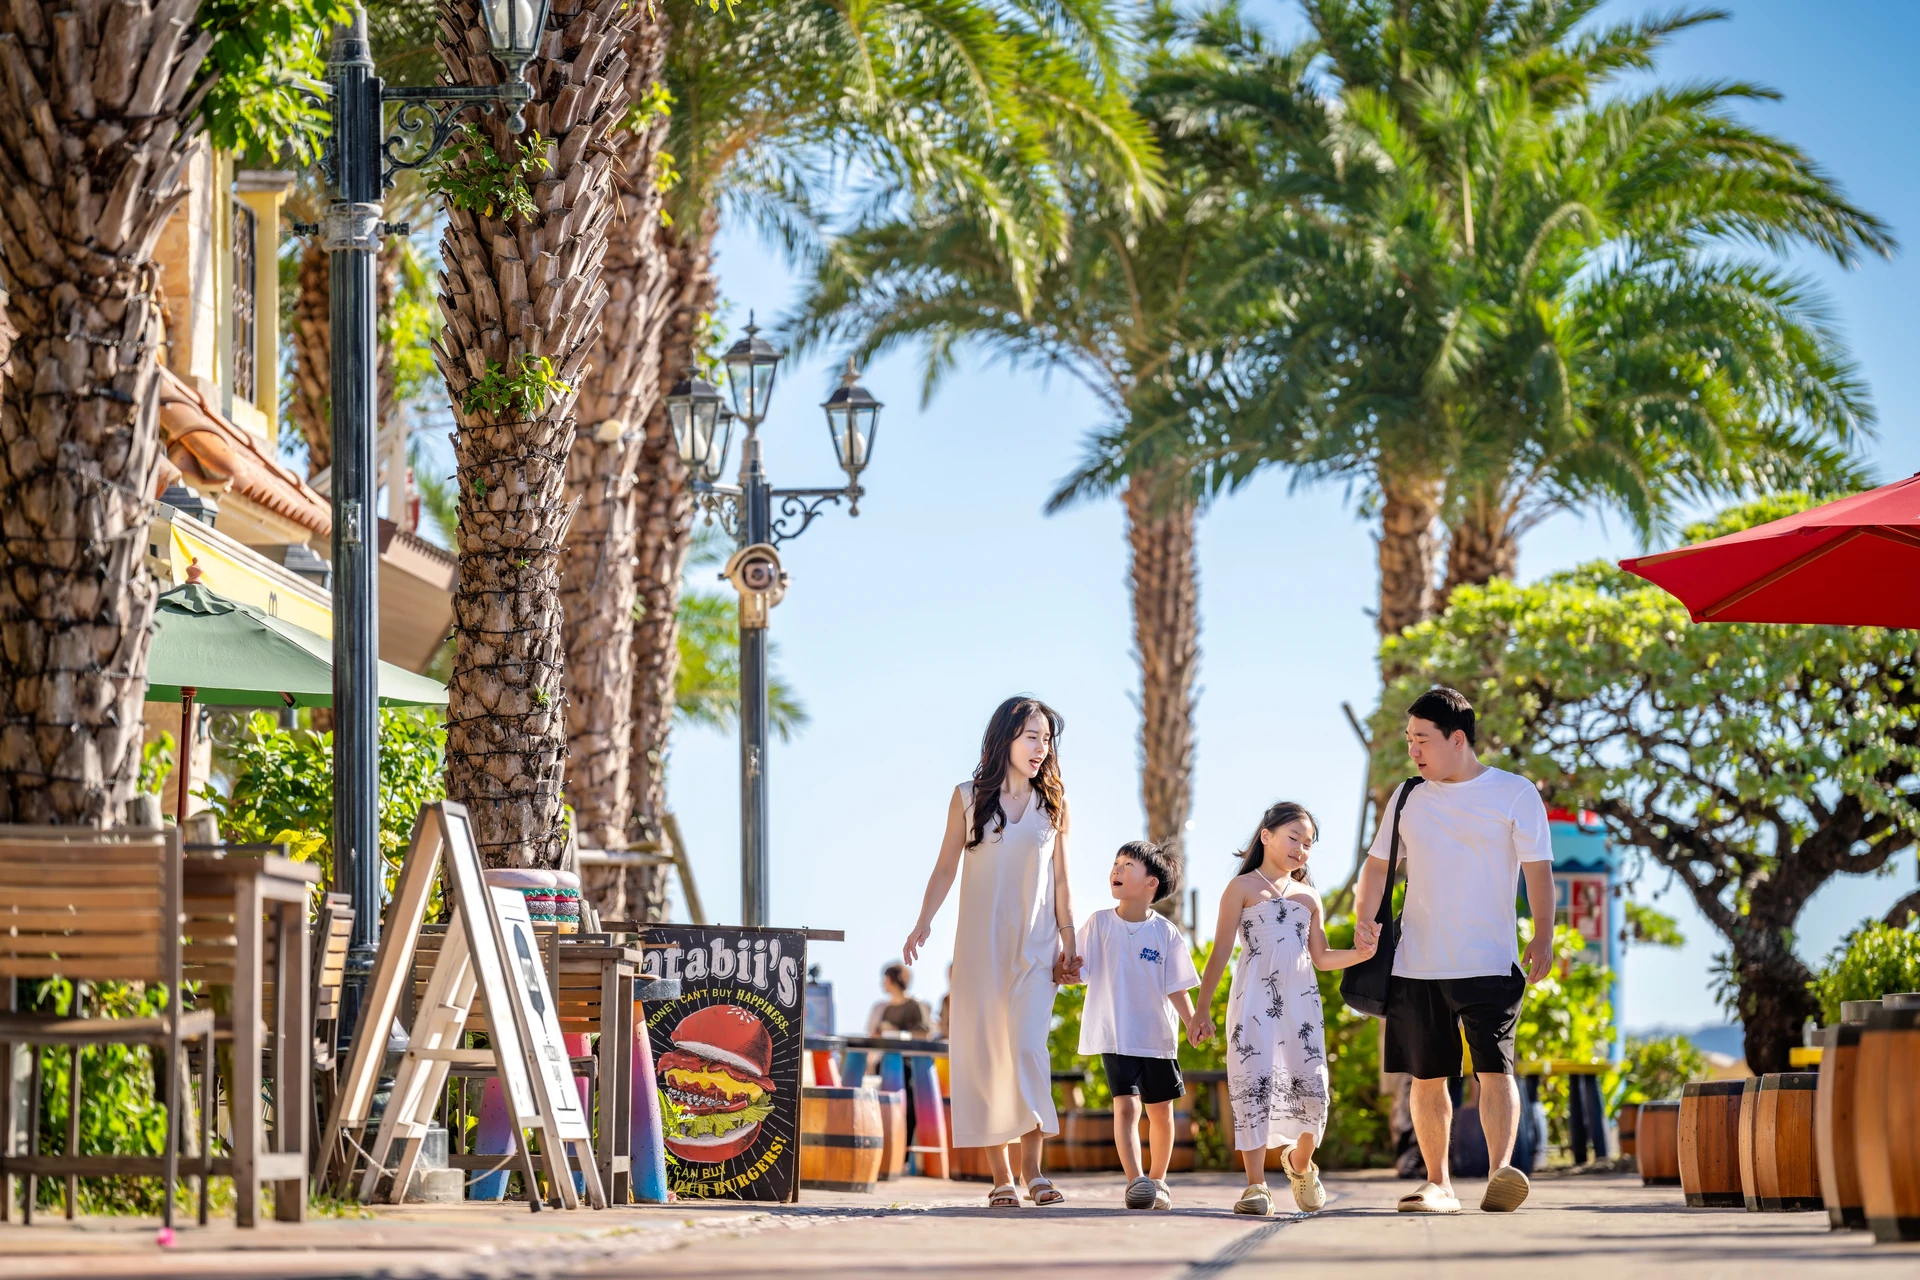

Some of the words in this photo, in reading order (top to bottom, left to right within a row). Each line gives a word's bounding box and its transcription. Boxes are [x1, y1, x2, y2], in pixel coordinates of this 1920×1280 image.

[646, 1000, 677, 1030] MONEY
[679, 988, 708, 1005] CAN'T
[712, 988, 733, 999] BUY
[735, 988, 790, 1037] HAPPINESS...
[674, 1166, 699, 1179] CAN
[702, 1164, 727, 1179] BUY
[713, 1135, 788, 1196] BURGERS!
